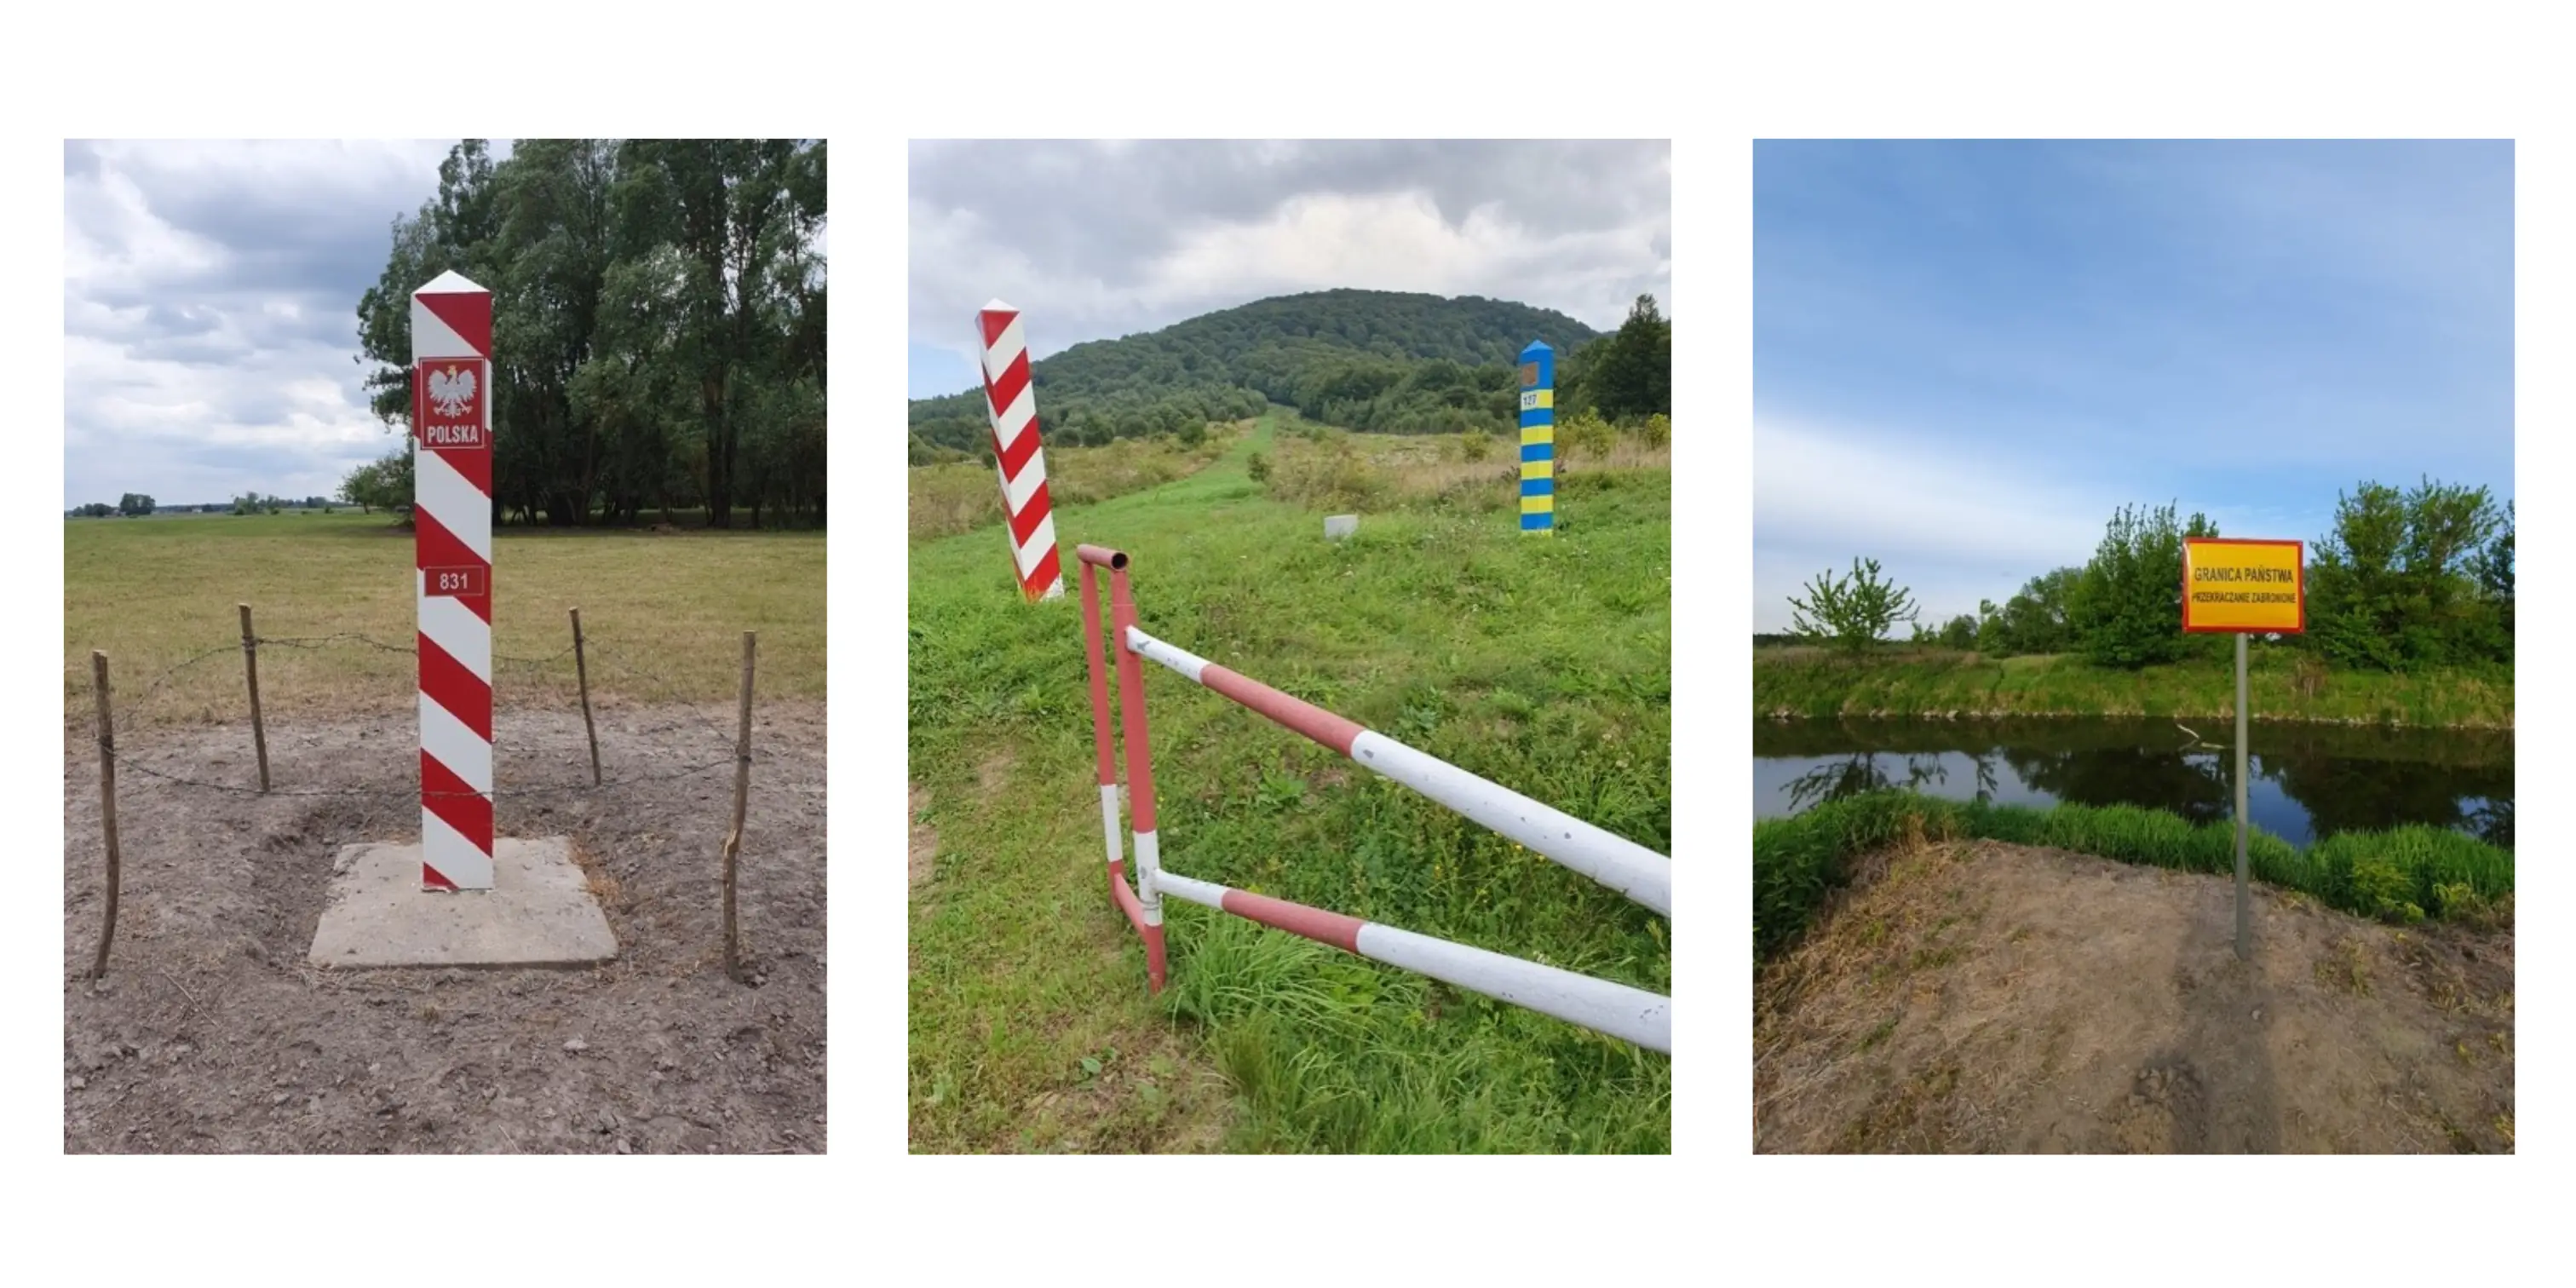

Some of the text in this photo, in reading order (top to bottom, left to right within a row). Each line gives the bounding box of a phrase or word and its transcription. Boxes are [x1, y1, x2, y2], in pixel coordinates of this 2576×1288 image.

[1522, 394, 1537, 406] 127
[428, 425, 479, 443] POLSKA
[440, 572, 468, 589] 831
[2194, 565, 2293, 583] GRANICA PAŃSTWA
